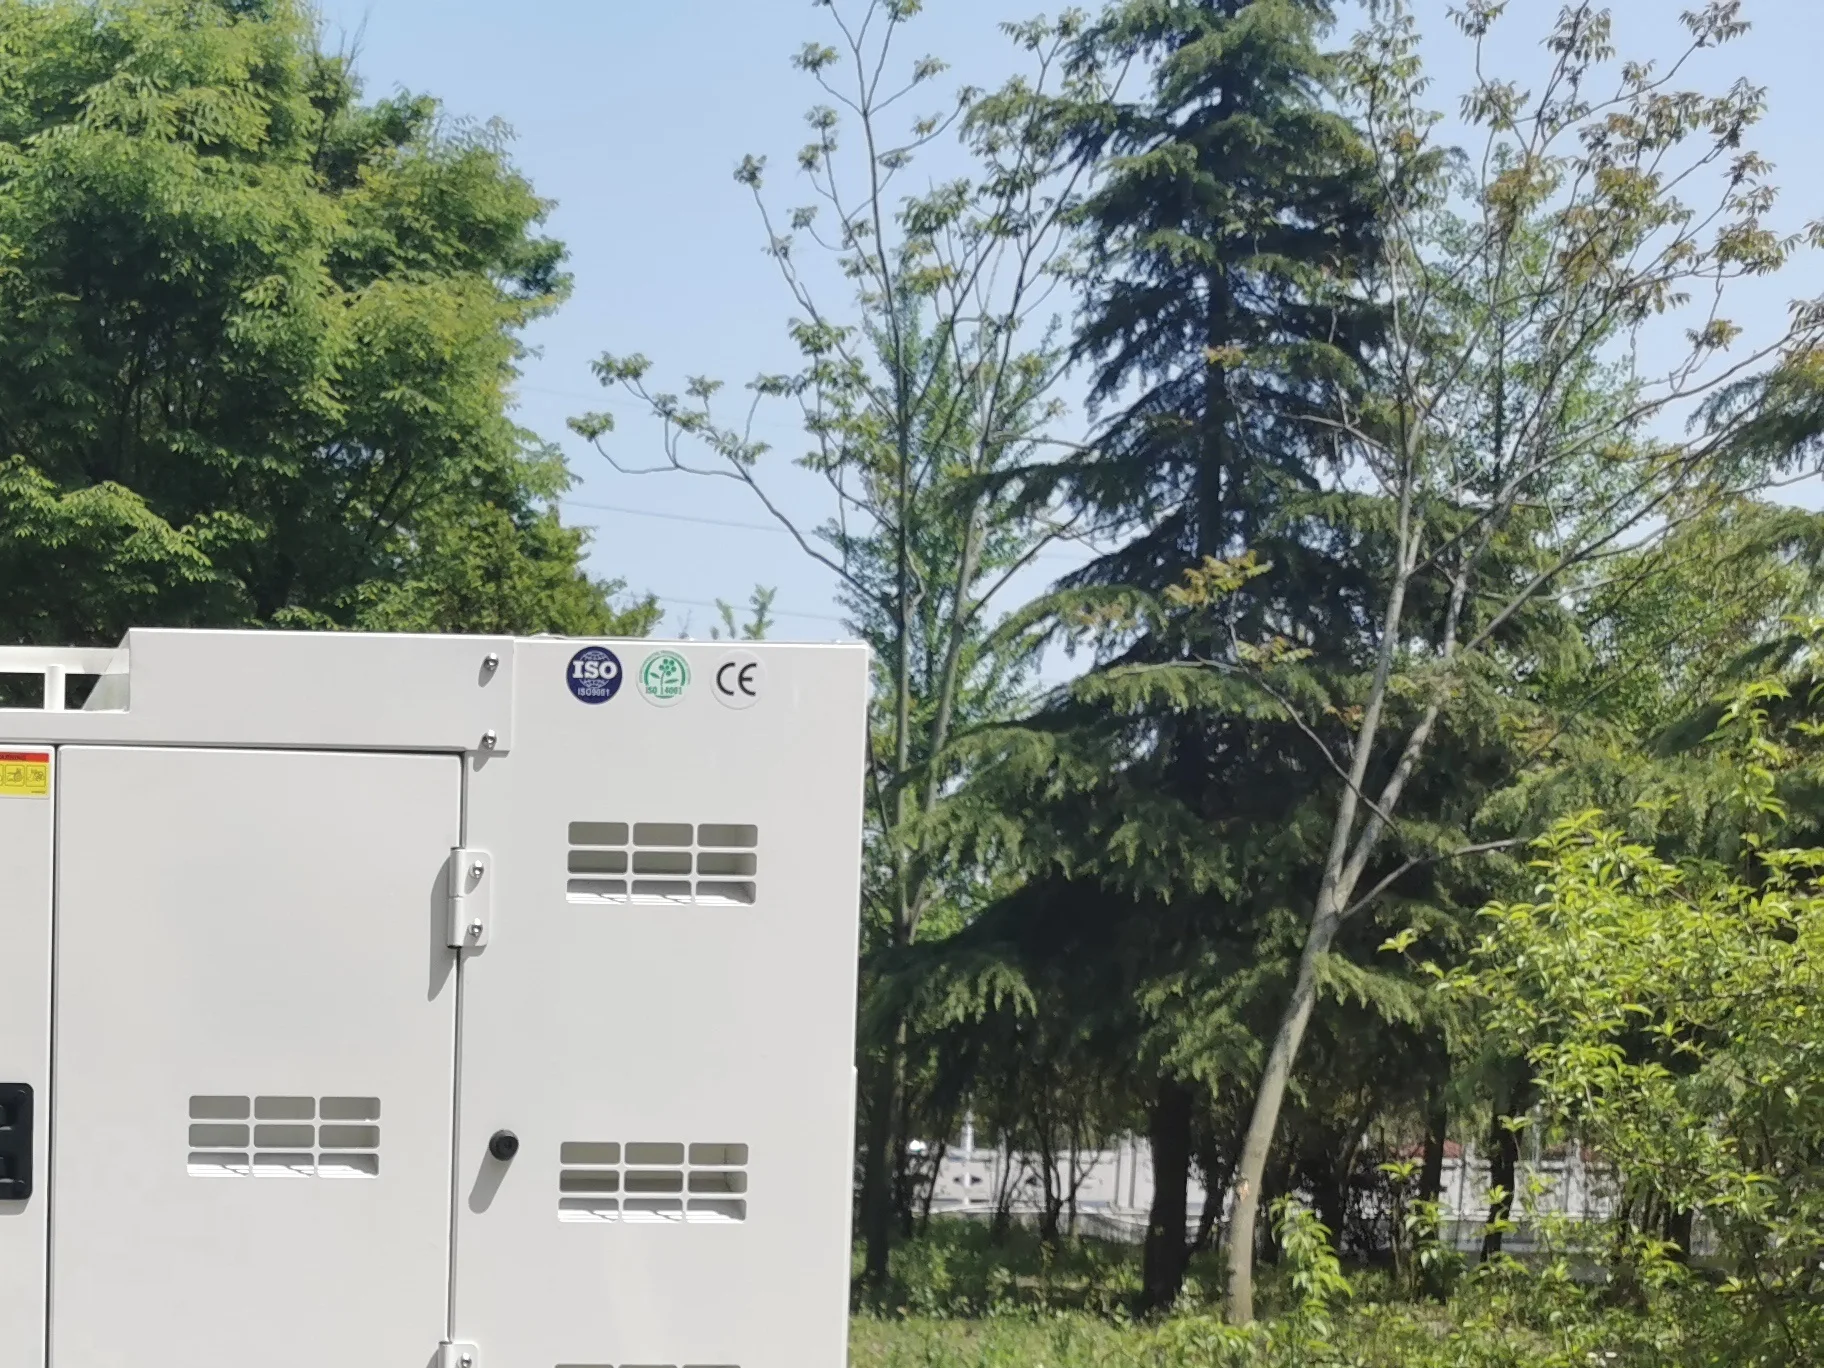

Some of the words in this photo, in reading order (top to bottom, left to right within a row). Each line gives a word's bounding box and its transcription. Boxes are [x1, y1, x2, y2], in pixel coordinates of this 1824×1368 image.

[572, 660, 618, 680] ISO
[716, 662, 757, 697] CE
[577, 687, 610, 697] ISO9001
